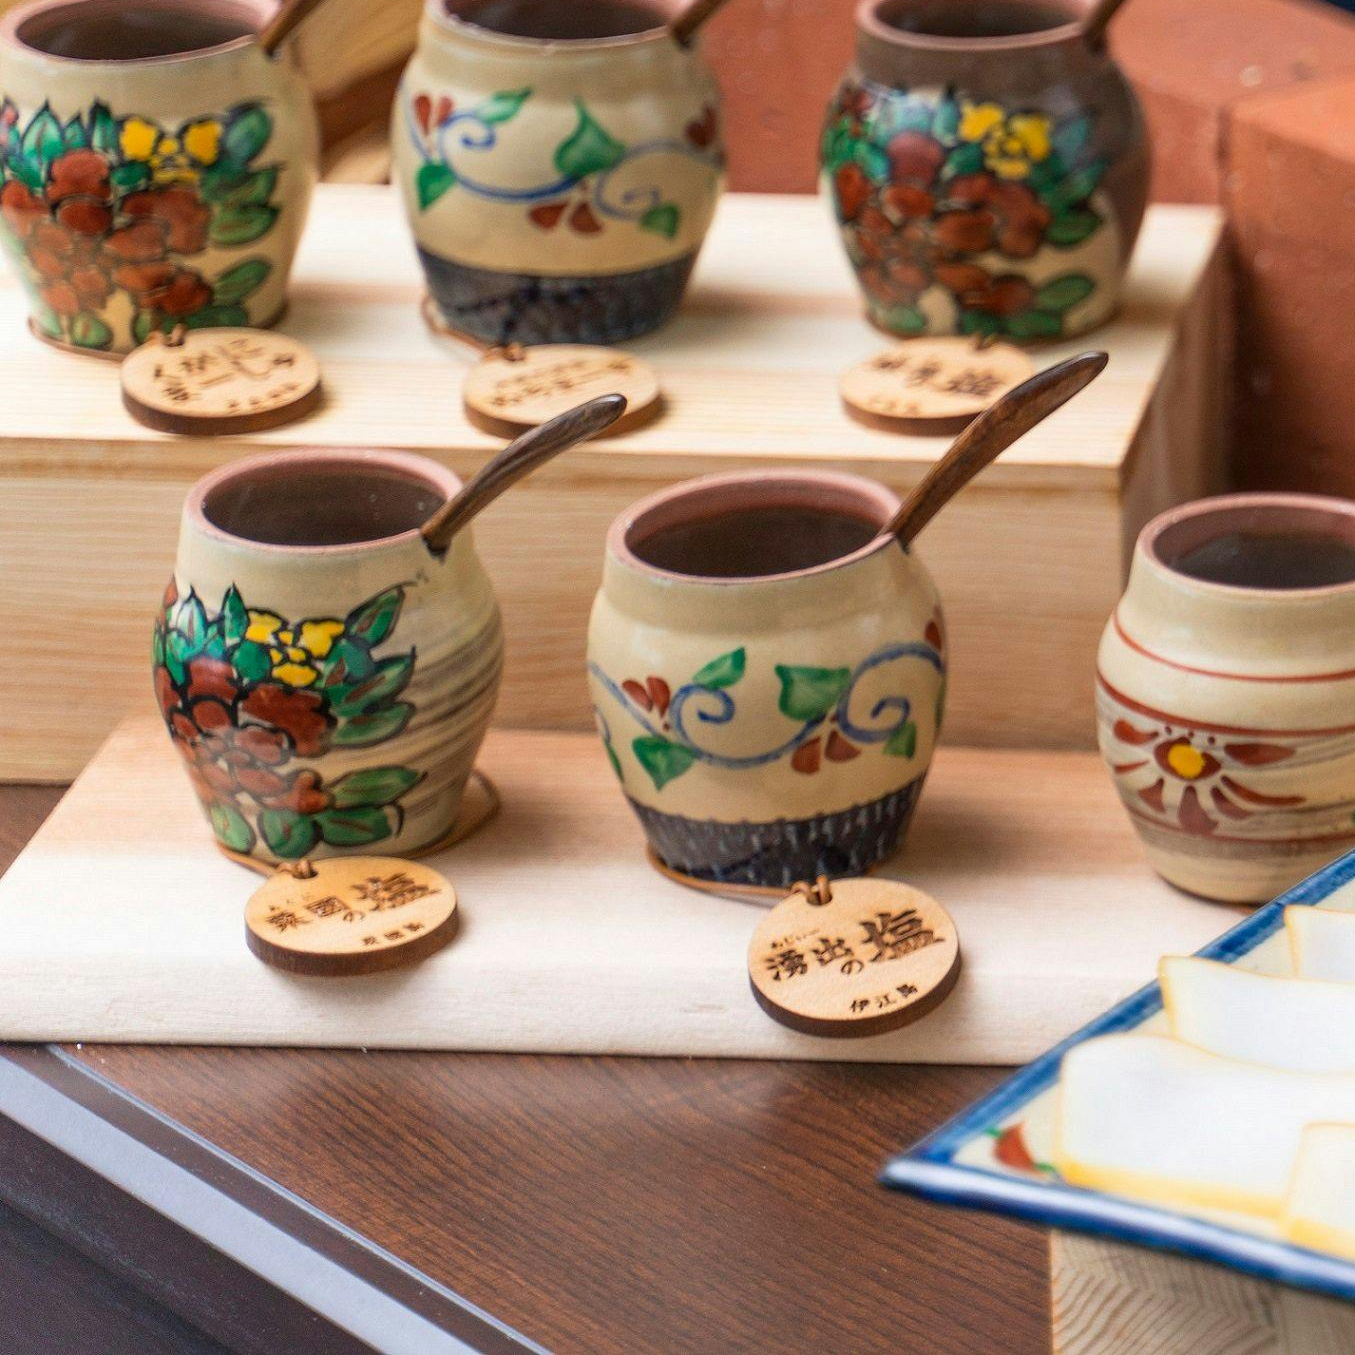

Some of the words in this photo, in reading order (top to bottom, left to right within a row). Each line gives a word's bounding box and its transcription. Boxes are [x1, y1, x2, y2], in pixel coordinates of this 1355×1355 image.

[765, 909, 945, 981] 湧出の塩
[851, 984, 918, 1014] 伊江島
